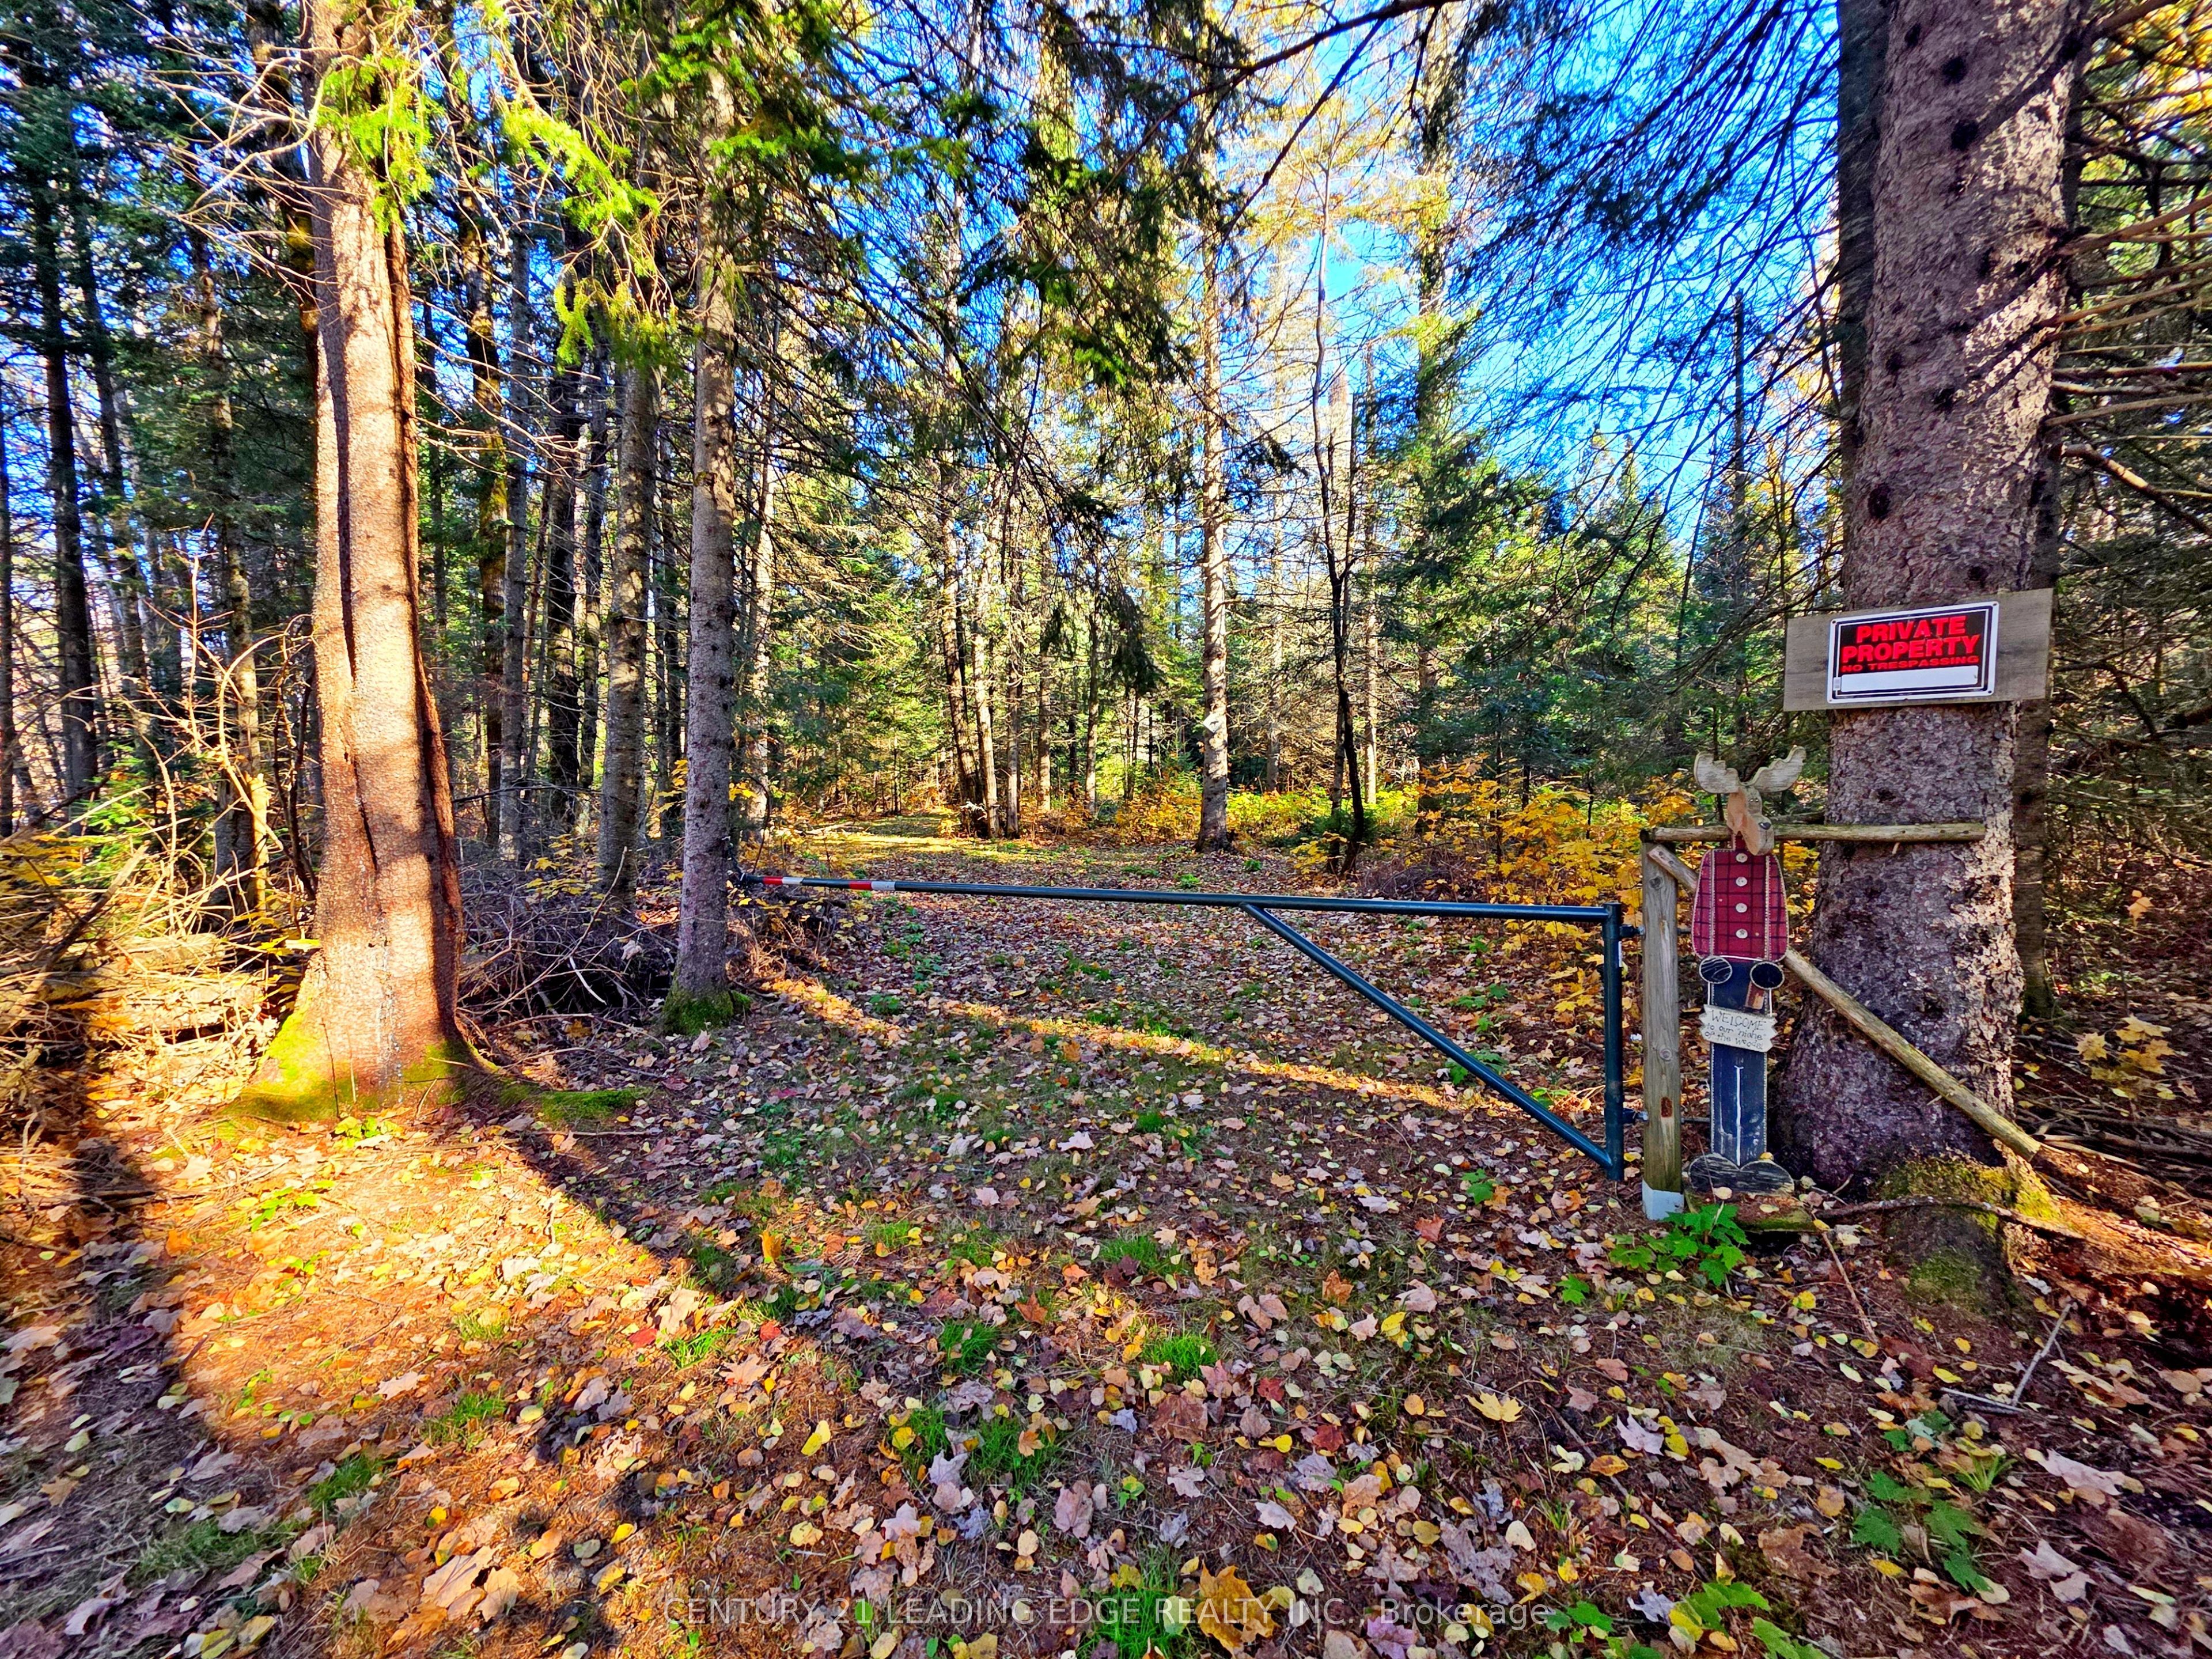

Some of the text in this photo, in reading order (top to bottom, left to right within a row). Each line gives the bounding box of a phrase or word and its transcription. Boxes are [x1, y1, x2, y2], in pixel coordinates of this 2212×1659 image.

[1857, 616, 1967, 643] PRIVATE
[1843, 635, 1980, 663] PROPERTY
[1842, 656, 1979, 672] NO TRESPASSING
[1712, 1010, 1766, 1030] WELCOME
[1718, 1033, 1731, 1041] the
